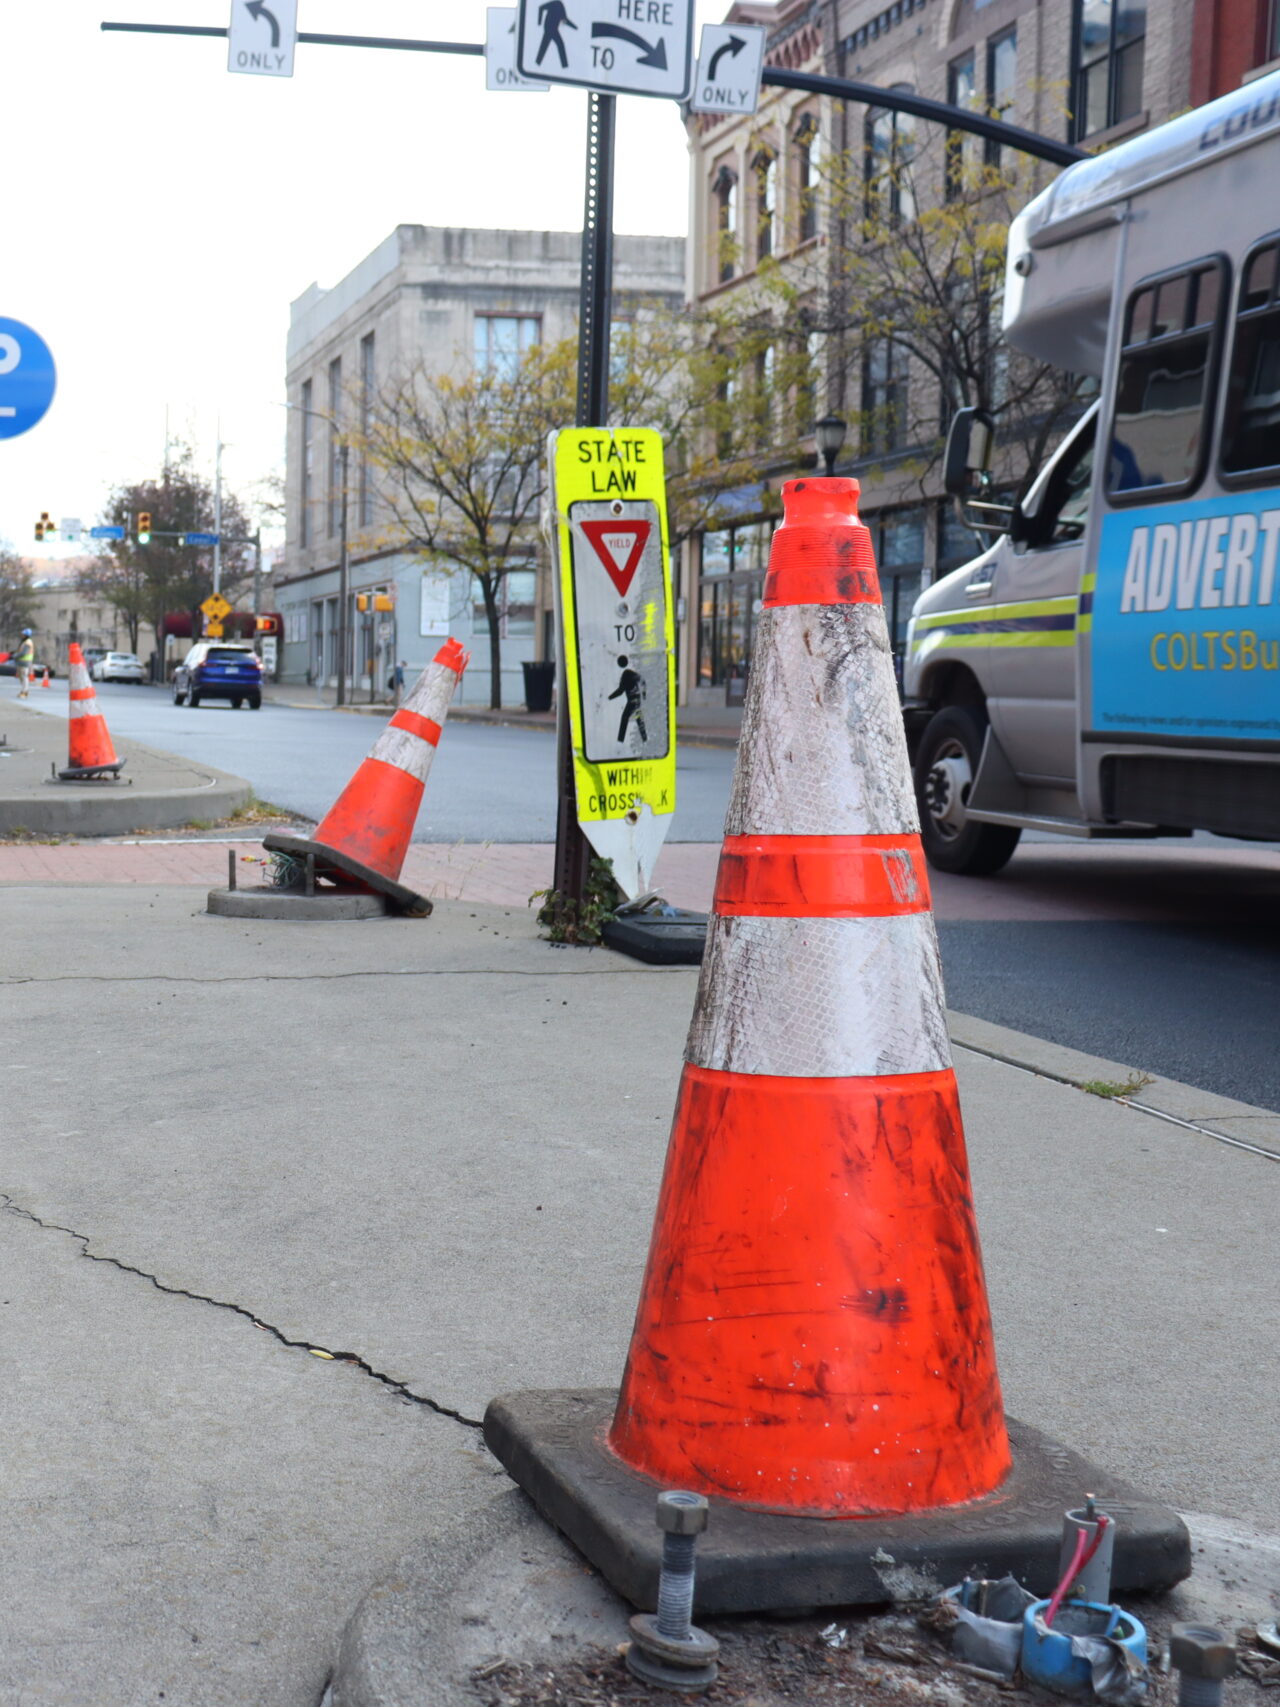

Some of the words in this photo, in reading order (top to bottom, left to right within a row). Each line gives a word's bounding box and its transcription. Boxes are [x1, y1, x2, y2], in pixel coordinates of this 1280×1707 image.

[618, 0, 674, 26] HERE
[237, 50, 286, 71] ONLY
[591, 46, 615, 71] TO
[496, 67, 529, 85] ON
[703, 86, 749, 106] ONLY
[1198, 88, 1280, 151] COU
[578, 440, 646, 463] STATE
[592, 470, 637, 493] LAW
[608, 538, 631, 549] YIELD
[1120, 508, 1280, 614] ADVERT
[614, 624, 635, 642] TO
[589, 789, 668, 813] CROSSK
